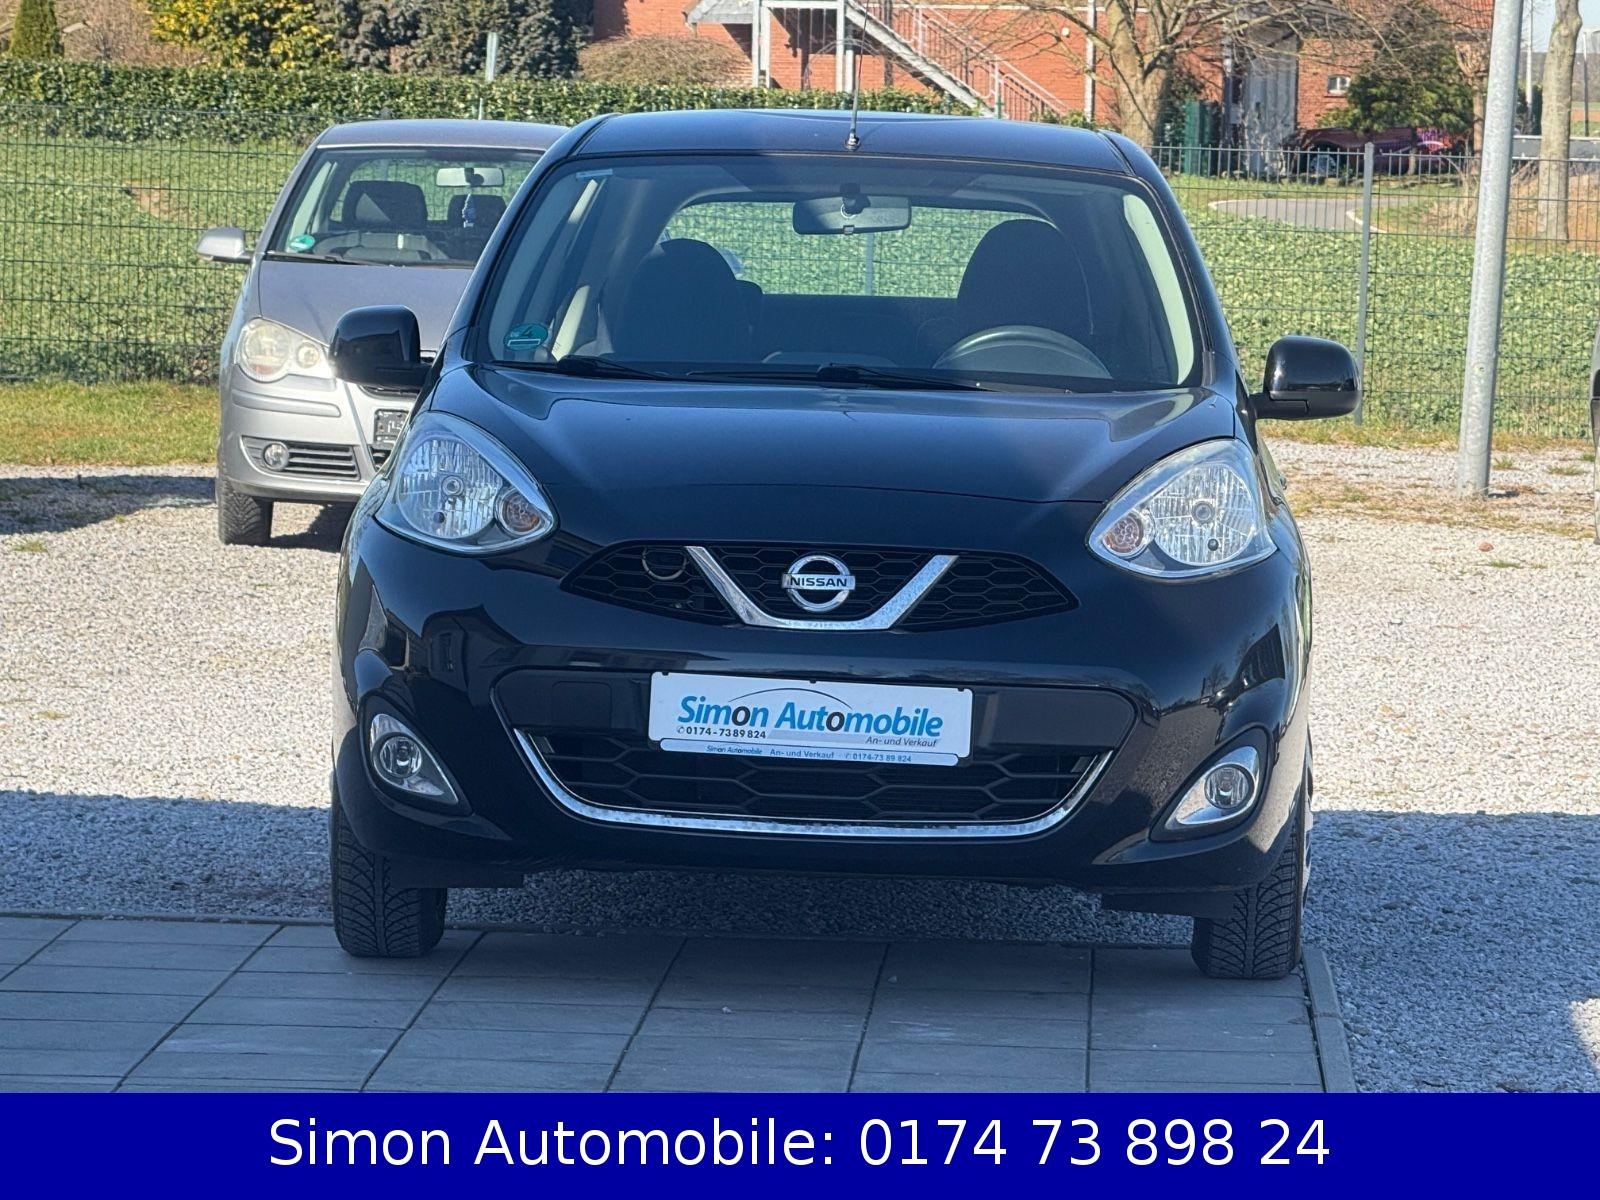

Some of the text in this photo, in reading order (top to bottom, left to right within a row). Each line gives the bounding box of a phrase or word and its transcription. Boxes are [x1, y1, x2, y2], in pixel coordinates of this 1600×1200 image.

[790, 576, 847, 587] NISSAN
[677, 695, 943, 737] Simon Automobile
[883, 738, 902, 746] und
[903, 738, 937, 748] Verkauf
[706, 745, 726, 753] Simon
[727, 746, 763, 755] Automobile
[803, 750, 834, 759] Verkauf
